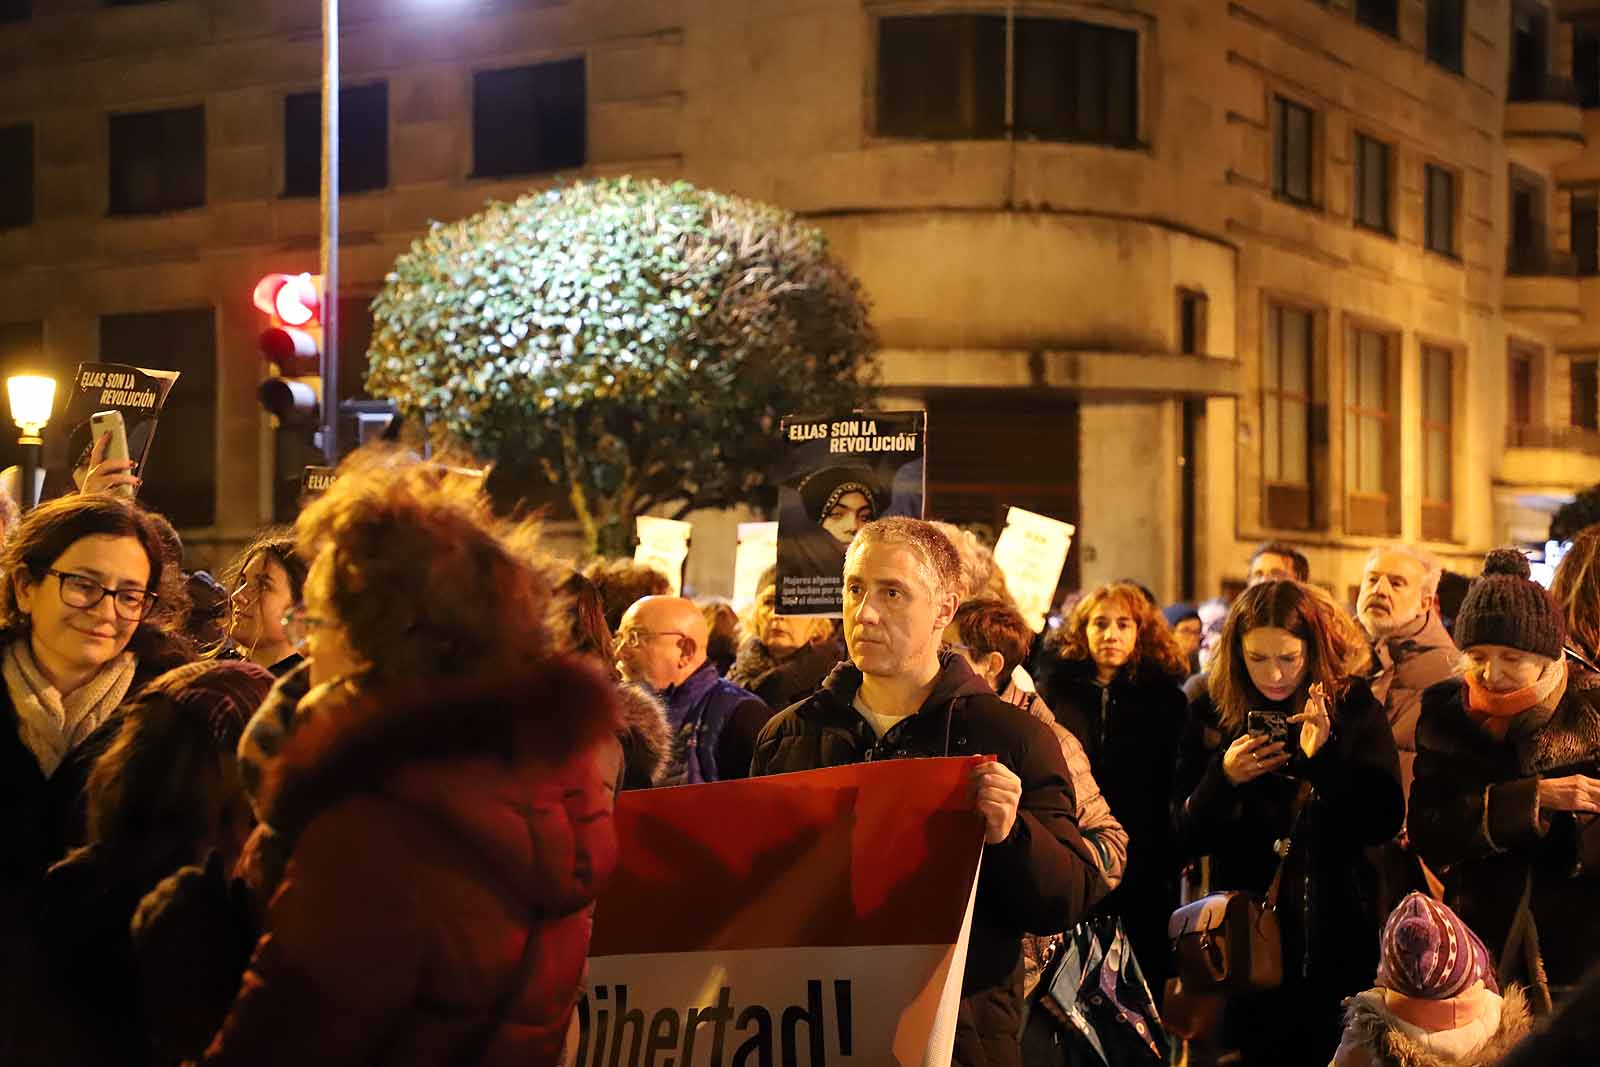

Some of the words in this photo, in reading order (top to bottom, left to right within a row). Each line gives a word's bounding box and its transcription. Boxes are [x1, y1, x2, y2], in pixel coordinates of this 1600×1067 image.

[80, 371, 106, 388] ELLAS
[105, 373, 124, 389] SON
[123, 374, 135, 390] LA
[100, 388, 157, 408] REVOLUCIÓN
[789, 423, 828, 441] ELLAS
[831, 421, 859, 437] SON
[862, 420, 877, 436] LA
[830, 432, 916, 453] REVOLUCIÓN
